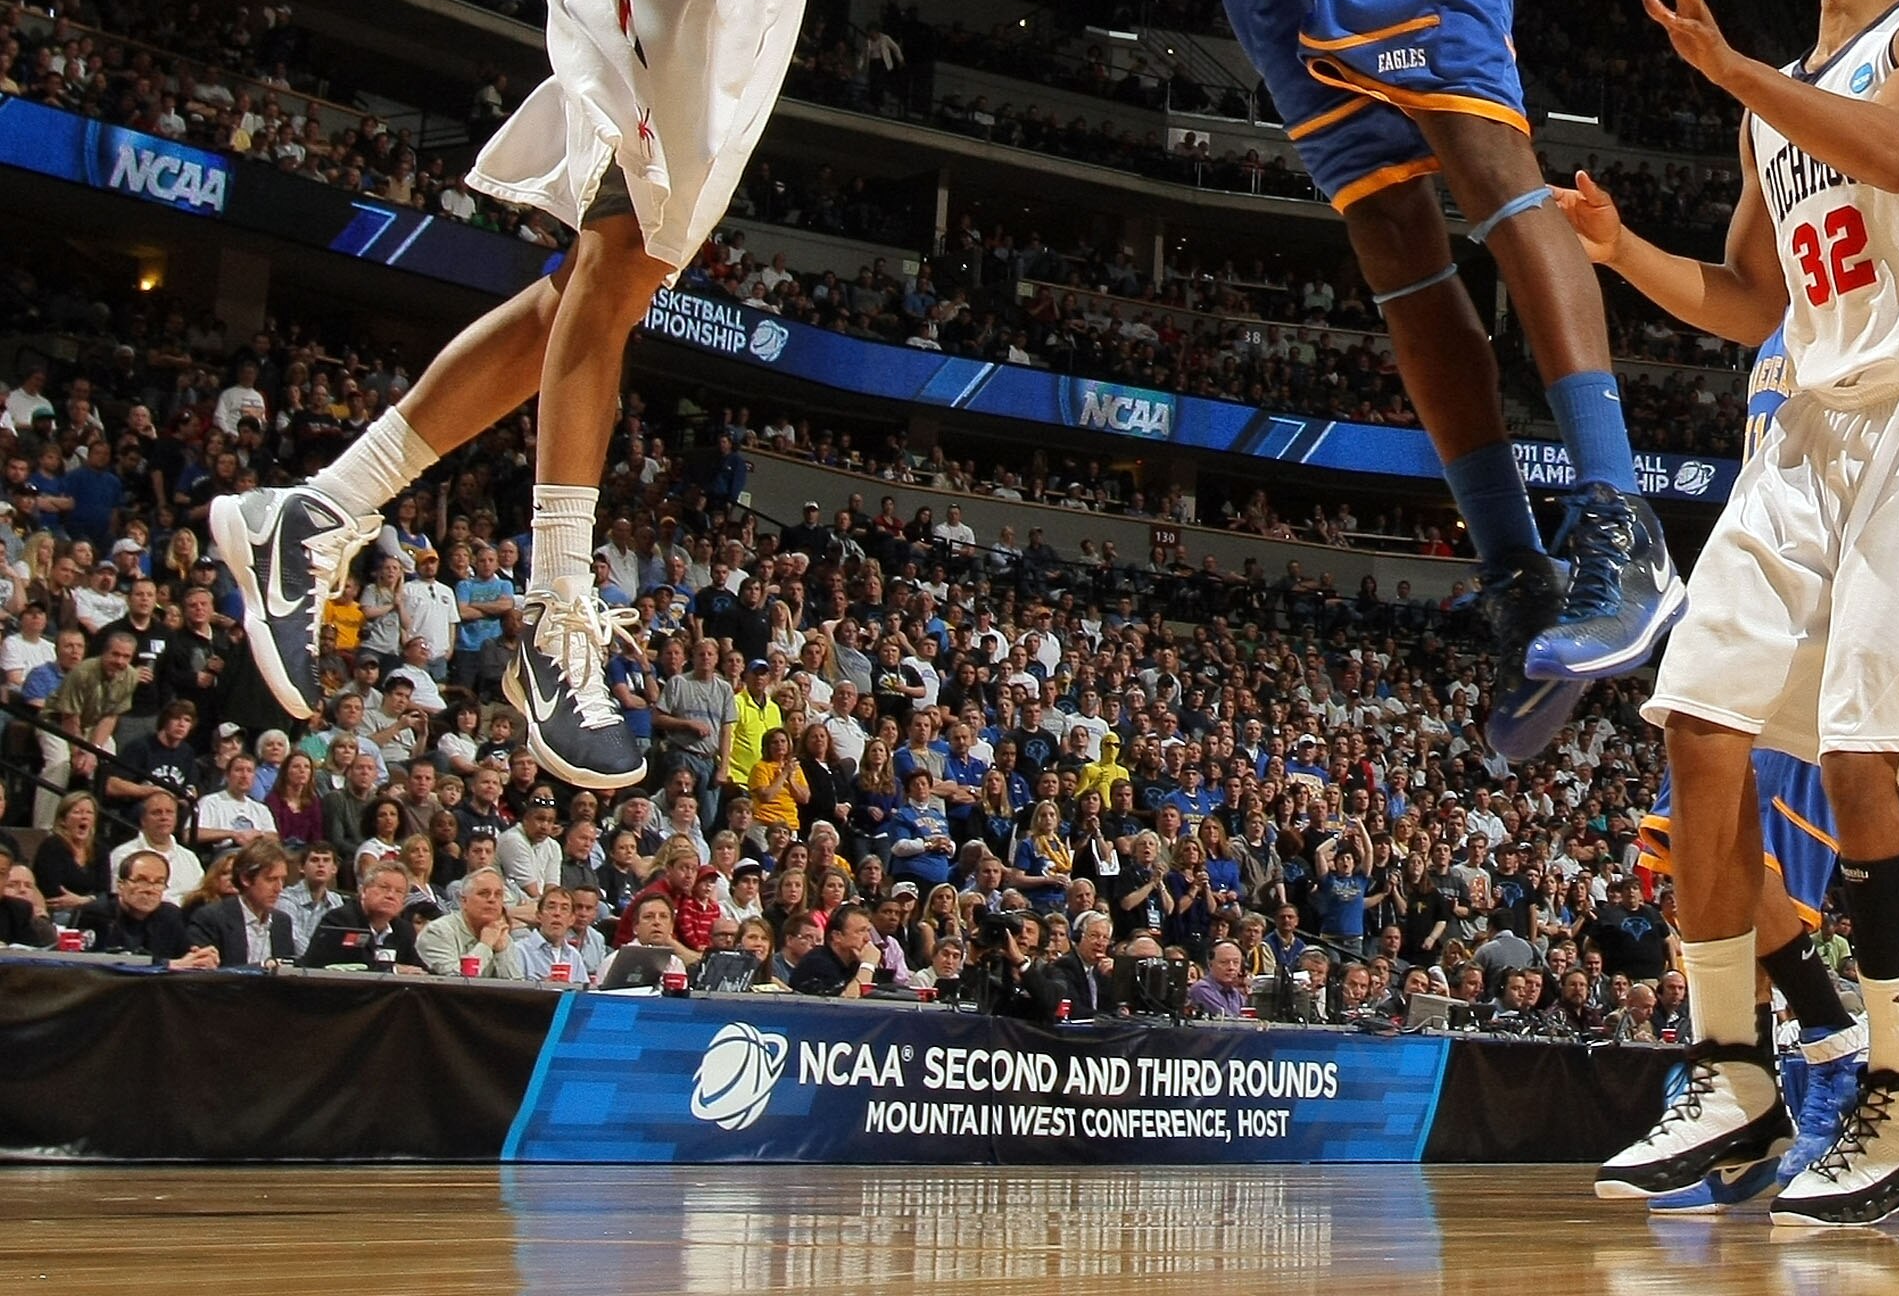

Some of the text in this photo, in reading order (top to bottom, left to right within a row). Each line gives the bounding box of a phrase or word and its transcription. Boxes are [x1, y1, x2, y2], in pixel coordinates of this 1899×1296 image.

[1378, 47, 1427, 73] EAGLES
[108, 144, 228, 211] NCAA
[1792, 204, 1877, 307] 32
[644, 306, 747, 354] PIONSHIP
[651, 287, 746, 331] SKETBALL
[1244, 331, 1261, 345] 38
[1078, 389, 1172, 437] NCAA
[1511, 442, 1537, 462] 011
[1155, 531, 1175, 544] 130
[923, 1047, 1058, 1093] SECOND
[1063, 1056, 1131, 1096] AND
[1137, 1058, 1224, 1097] THIRD
[1229, 1059, 1338, 1099] ROUNDS
[865, 1101, 1290, 1143] MOUNTAIN WEST CONFERENCE, HOST
